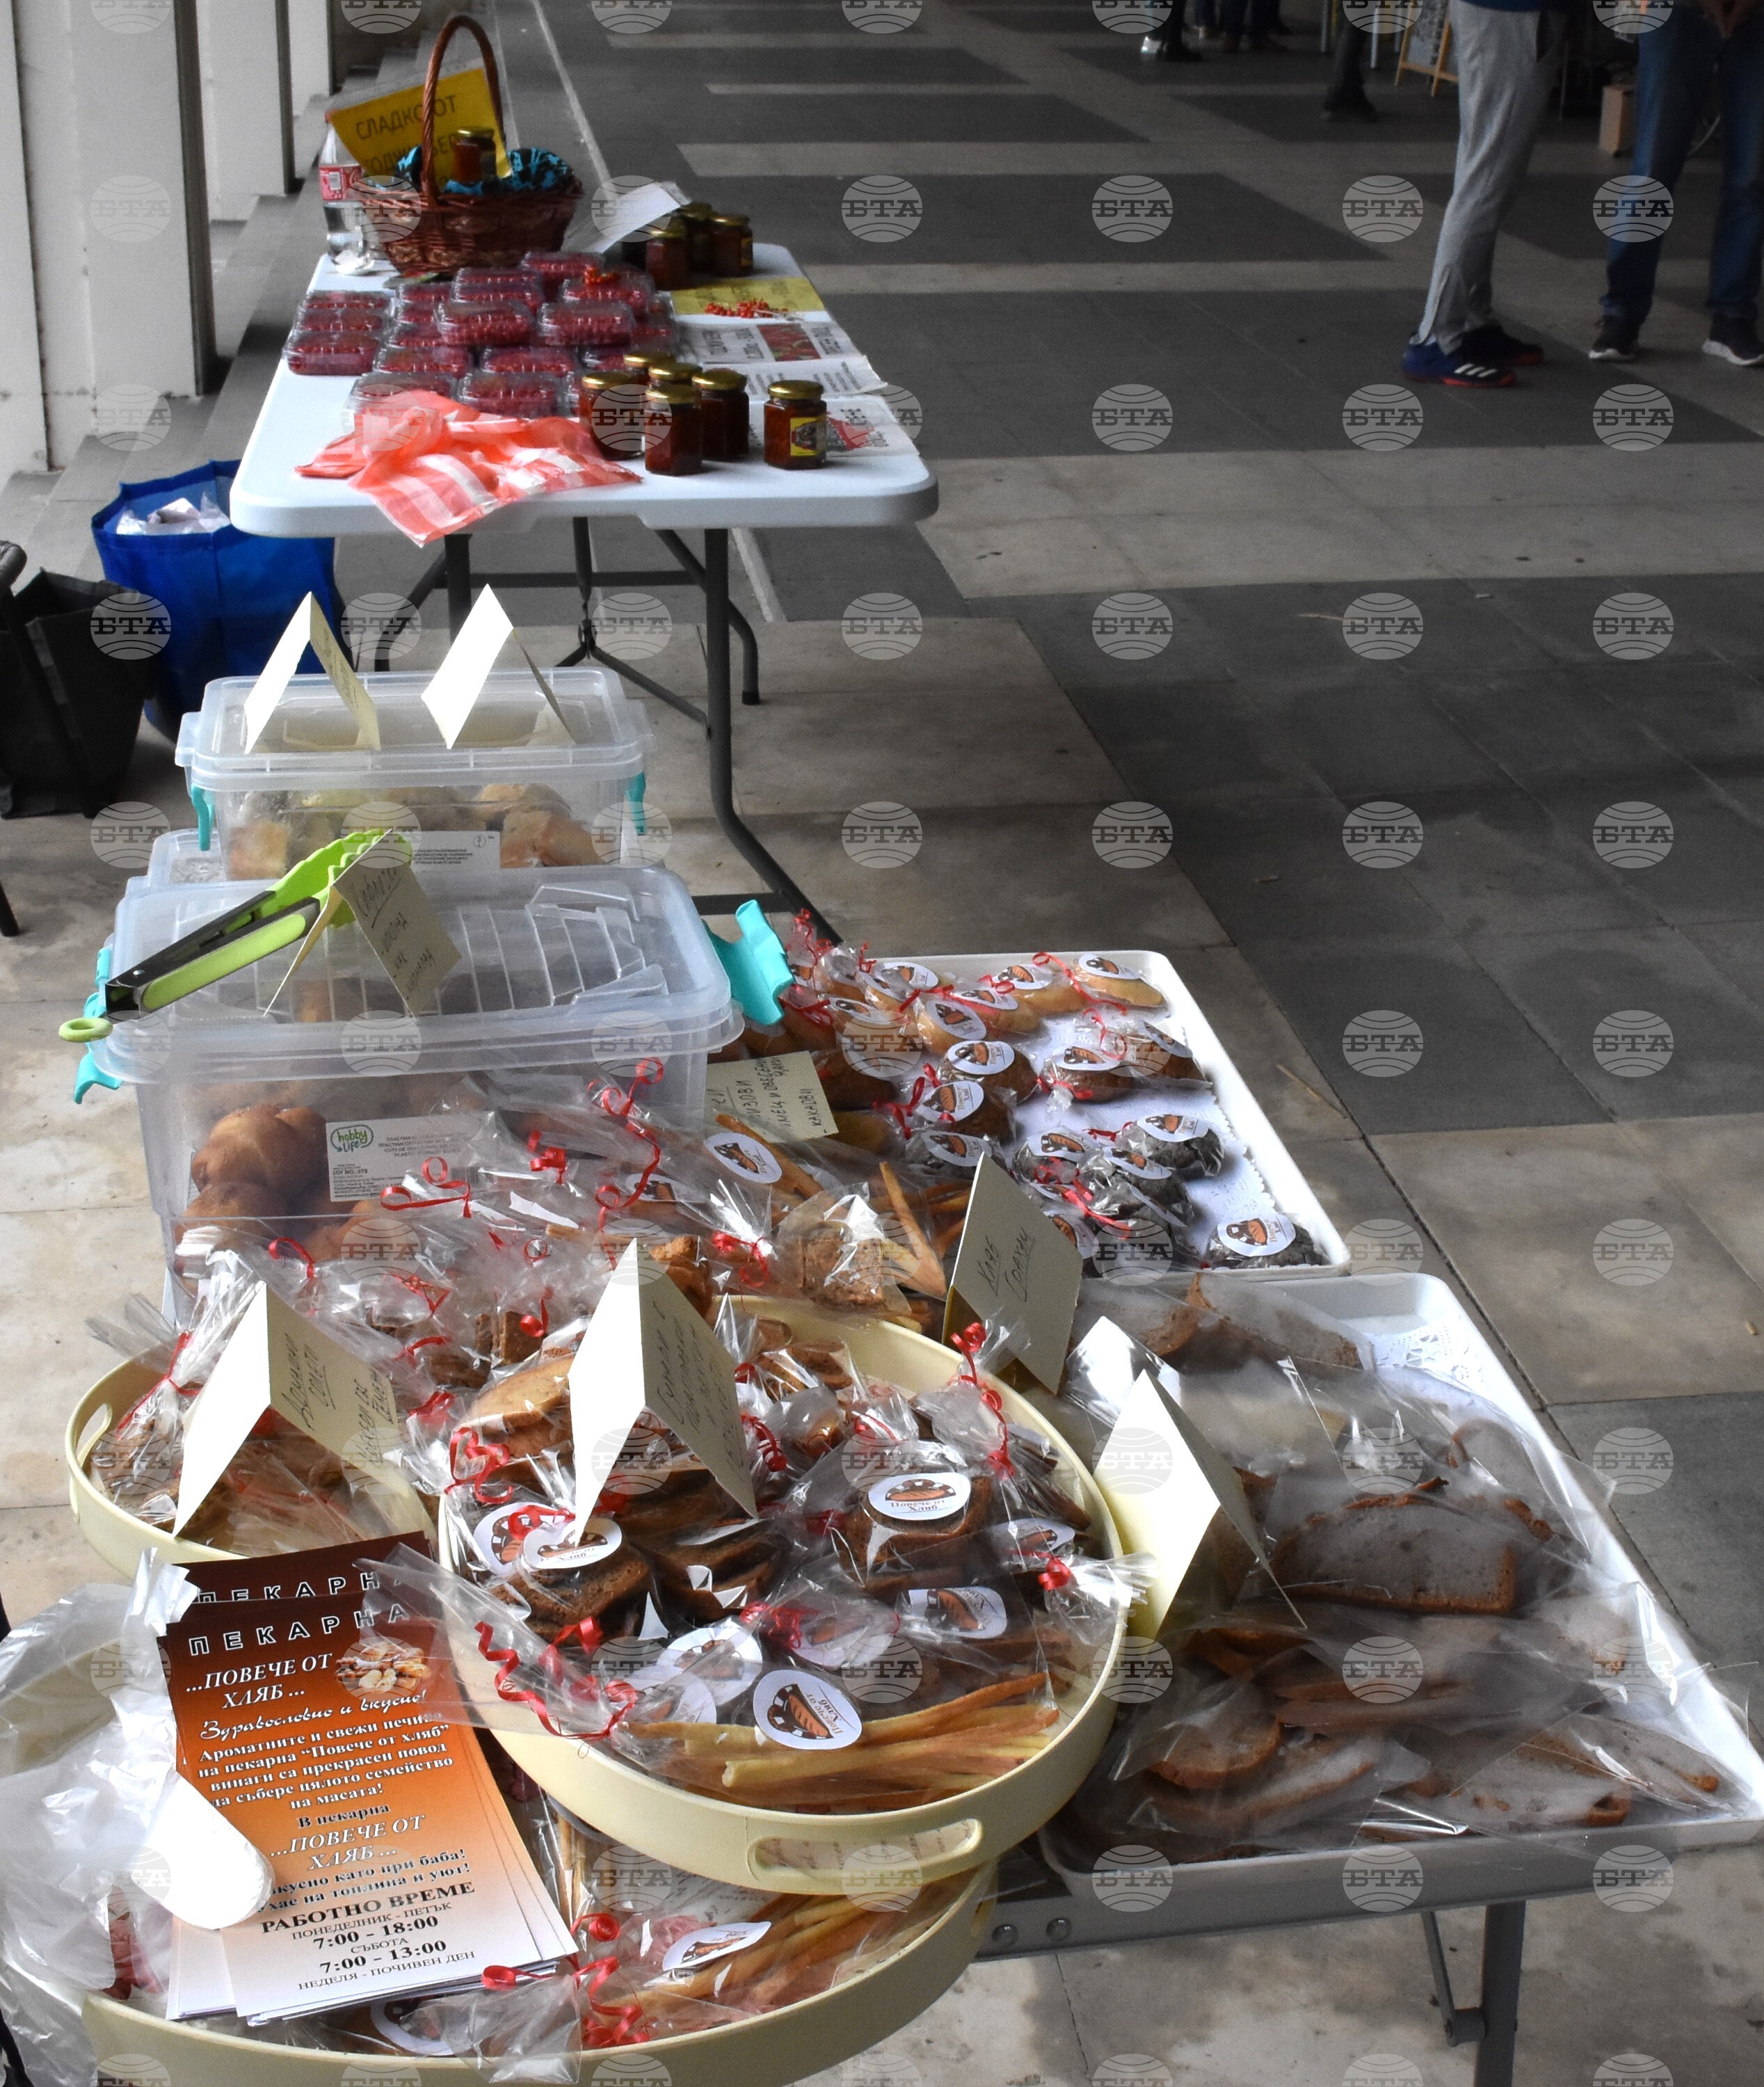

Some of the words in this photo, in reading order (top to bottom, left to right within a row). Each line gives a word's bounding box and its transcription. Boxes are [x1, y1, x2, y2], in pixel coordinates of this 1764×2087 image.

[337, 1128, 367, 1144] hobby
[189, 1603, 410, 1656] ПЕКАРНА
[186, 1659, 296, 1692] ...ПОВЕЧЕ
[301, 1653, 333, 1672] ОТ
[200, 1707, 334, 1741] Здравословно
[339, 1706, 353, 1715] и
[360, 1689, 427, 1713] вкусно!
[222, 1684, 284, 1709] ХЛЯБ
[818, 1698, 840, 1722] Хляб
[198, 1766, 219, 1778] на
[225, 1752, 297, 1773] пекарна
[378, 1736, 396, 1746] от
[199, 1735, 306, 1762] Ароматните
[310, 1733, 321, 1742] и
[326, 1722, 378, 1738] свежи
[211, 1773, 273, 1792] винаги
[278, 1769, 298, 1780] са
[303, 1752, 393, 1776] прекрасен
[398, 1743, 447, 1759] повод
[235, 1785, 294, 1803] събере
[299, 1773, 360, 1793] цялото
[365, 1757, 454, 1780] семейство
[289, 1798, 312, 1809] на
[316, 1782, 383, 1805] масата!
[269, 1821, 387, 1857] ...ПОВЕЧЕ
[392, 1814, 426, 1834] ОТ
[297, 1816, 312, 1830] В
[316, 1804, 391, 1826] пекарна
[307, 1844, 374, 1871] ХЛЯБ
[335, 1868, 375, 1883] като
[380, 1860, 415, 1874] при
[418, 1848, 466, 1866] баба!
[304, 1893, 325, 1905] на
[332, 1878, 408, 1898] топлина
[414, 1873, 424, 1882] и
[429, 1863, 471, 1882] уют!
[261, 1899, 381, 1933] РАБОТНО
[388, 1881, 475, 1908] ВРЕМЕ
[291, 1914, 392, 1940] ПОНЕДЕЛНИК
[403, 1901, 453, 1918] ПЕТЪК
[313, 1931, 360, 1949] 7:00
[383, 1914, 439, 1937] 18:00
[350, 1937, 409, 1954] СЪБОТА
[298, 1972, 358, 1990] НЕДЕЛЯ
[370, 1956, 442, 1976] ПОЧИВЕН
[446, 1951, 475, 1964] ДЕН
[319, 1956, 367, 1974] 7:00
[390, 1940, 447, 1960] 13:00
